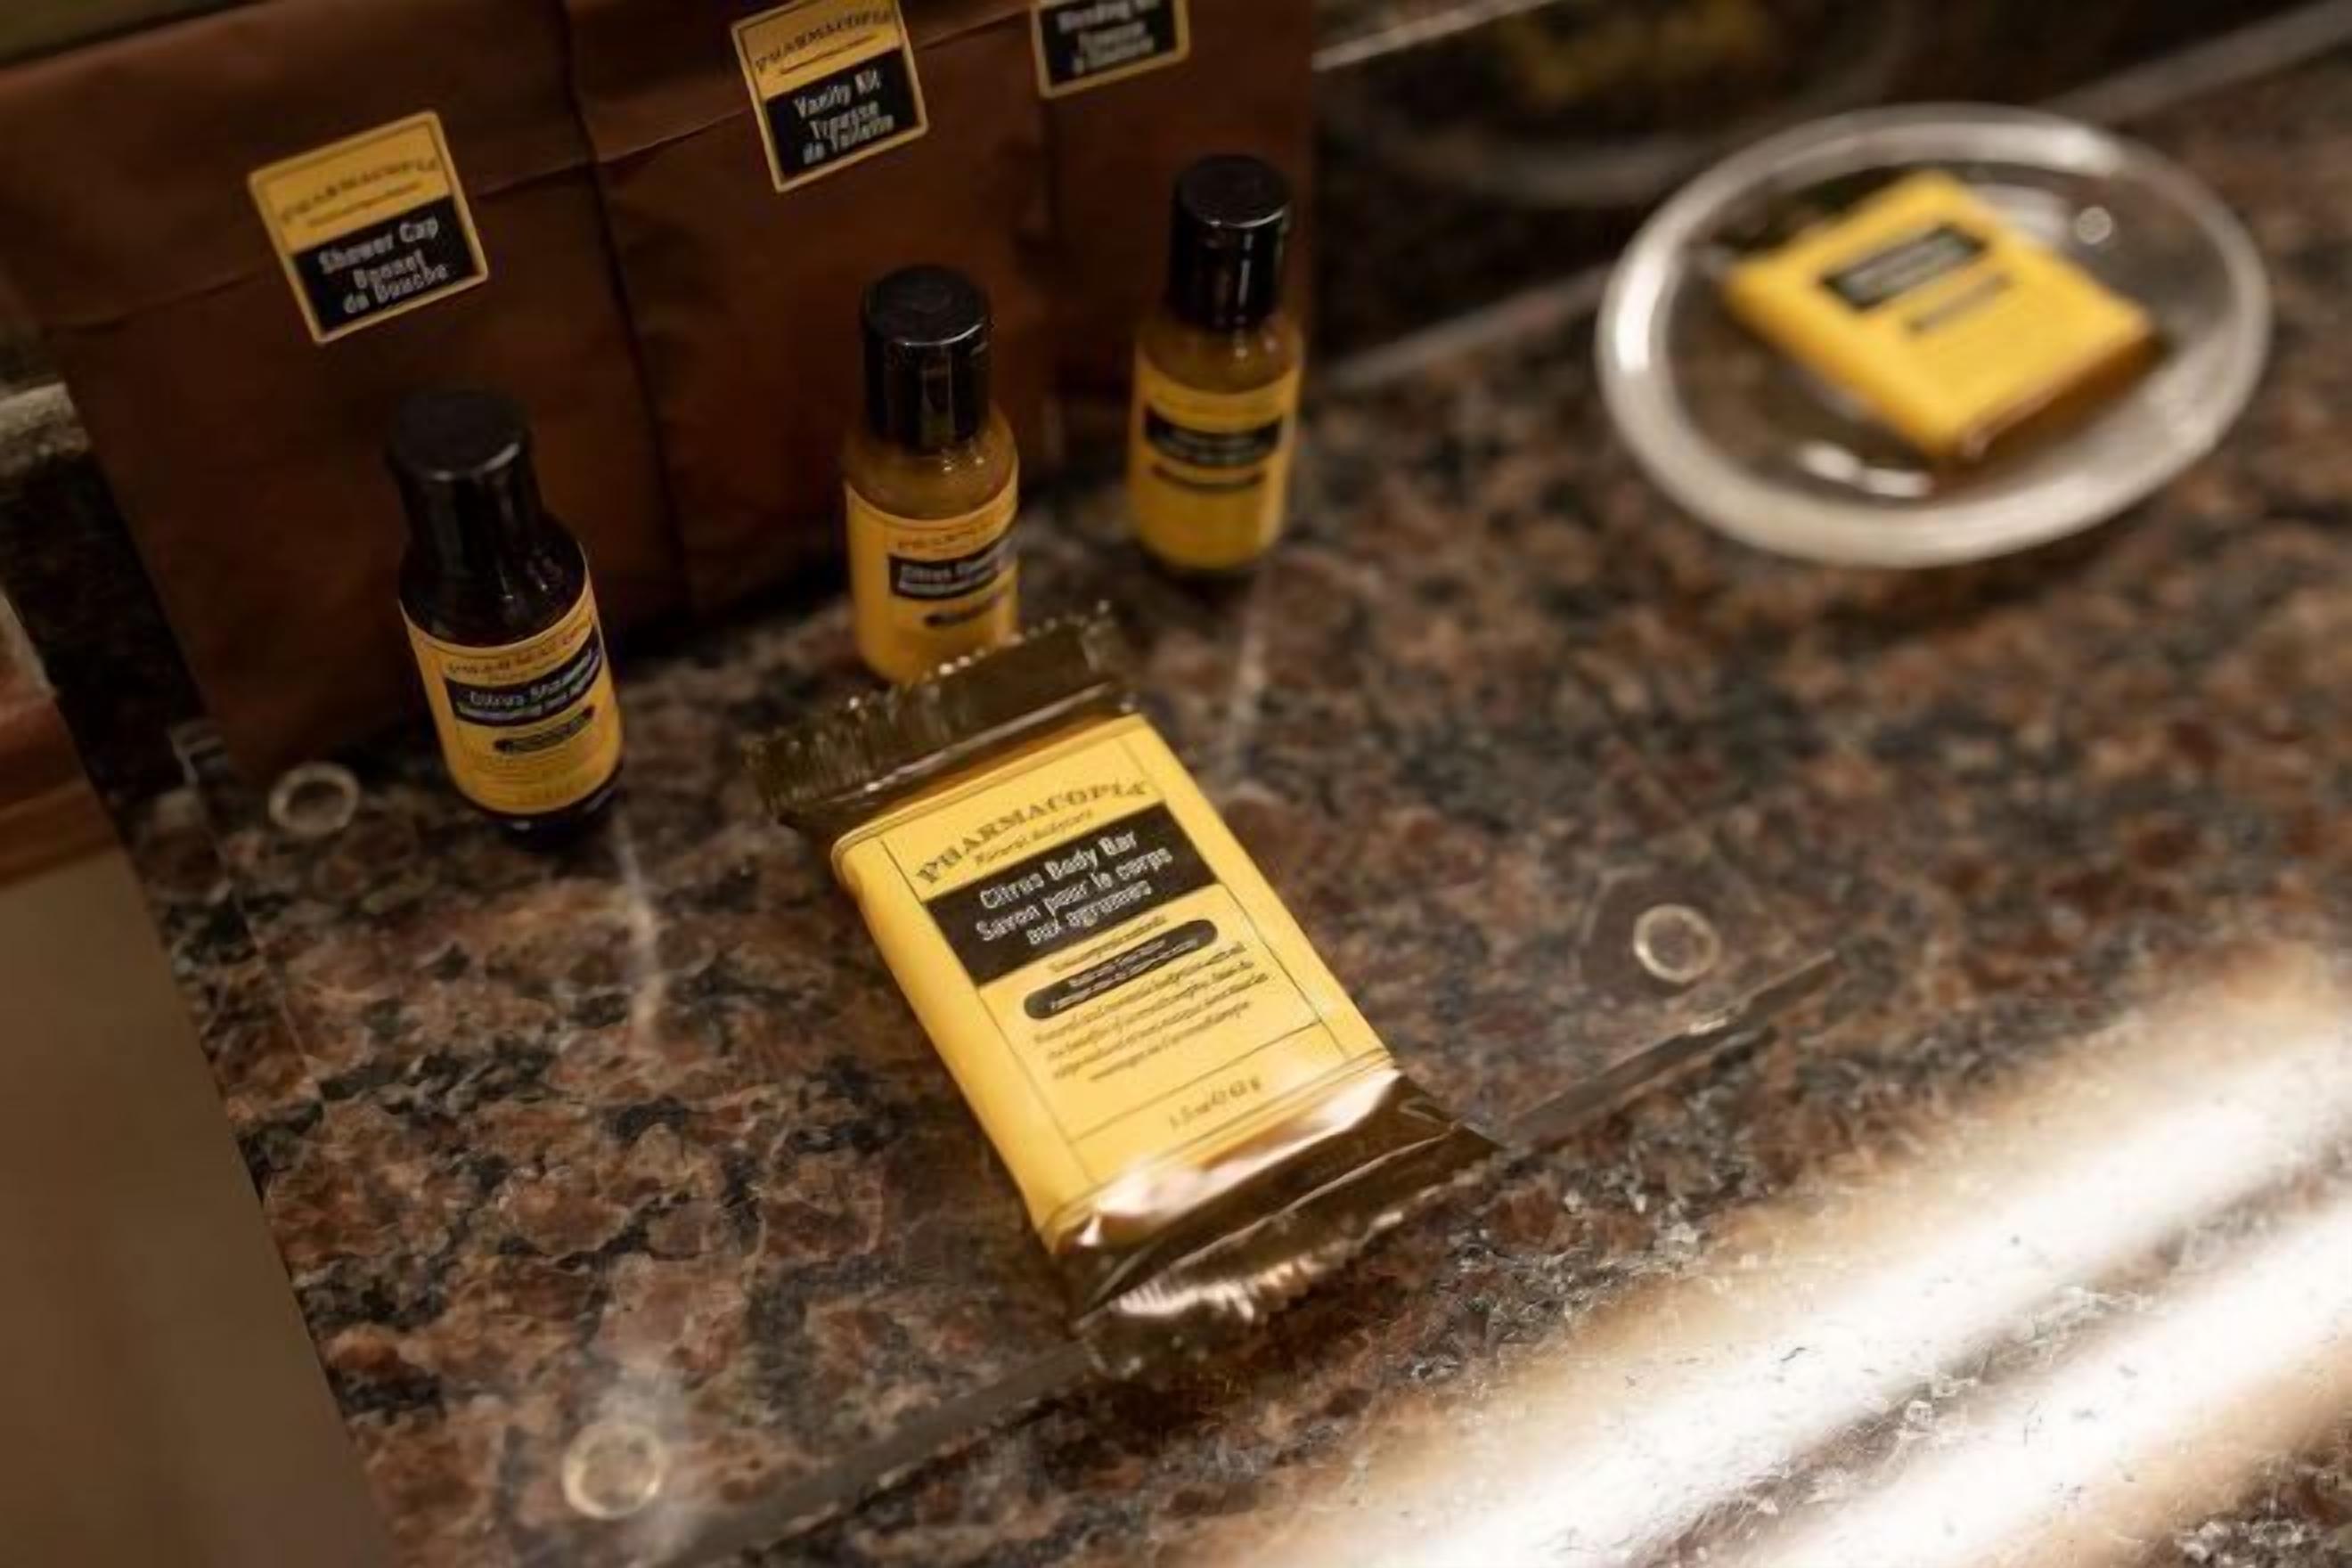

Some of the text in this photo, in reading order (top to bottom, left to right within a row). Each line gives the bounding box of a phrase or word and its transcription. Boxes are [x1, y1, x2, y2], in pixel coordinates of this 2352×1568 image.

[794, 85, 852, 118] Vanity
[318, 216, 439, 274] Shower Cap
[916, 780, 1147, 884] PHARMACOPIA
[976, 846, 1174, 942] Savon pour le corps
[979, 830, 1138, 910] Citrus Body Bar
[1025, 919, 1063, 946] aux
[1066, 879, 1153, 928] agrumes
